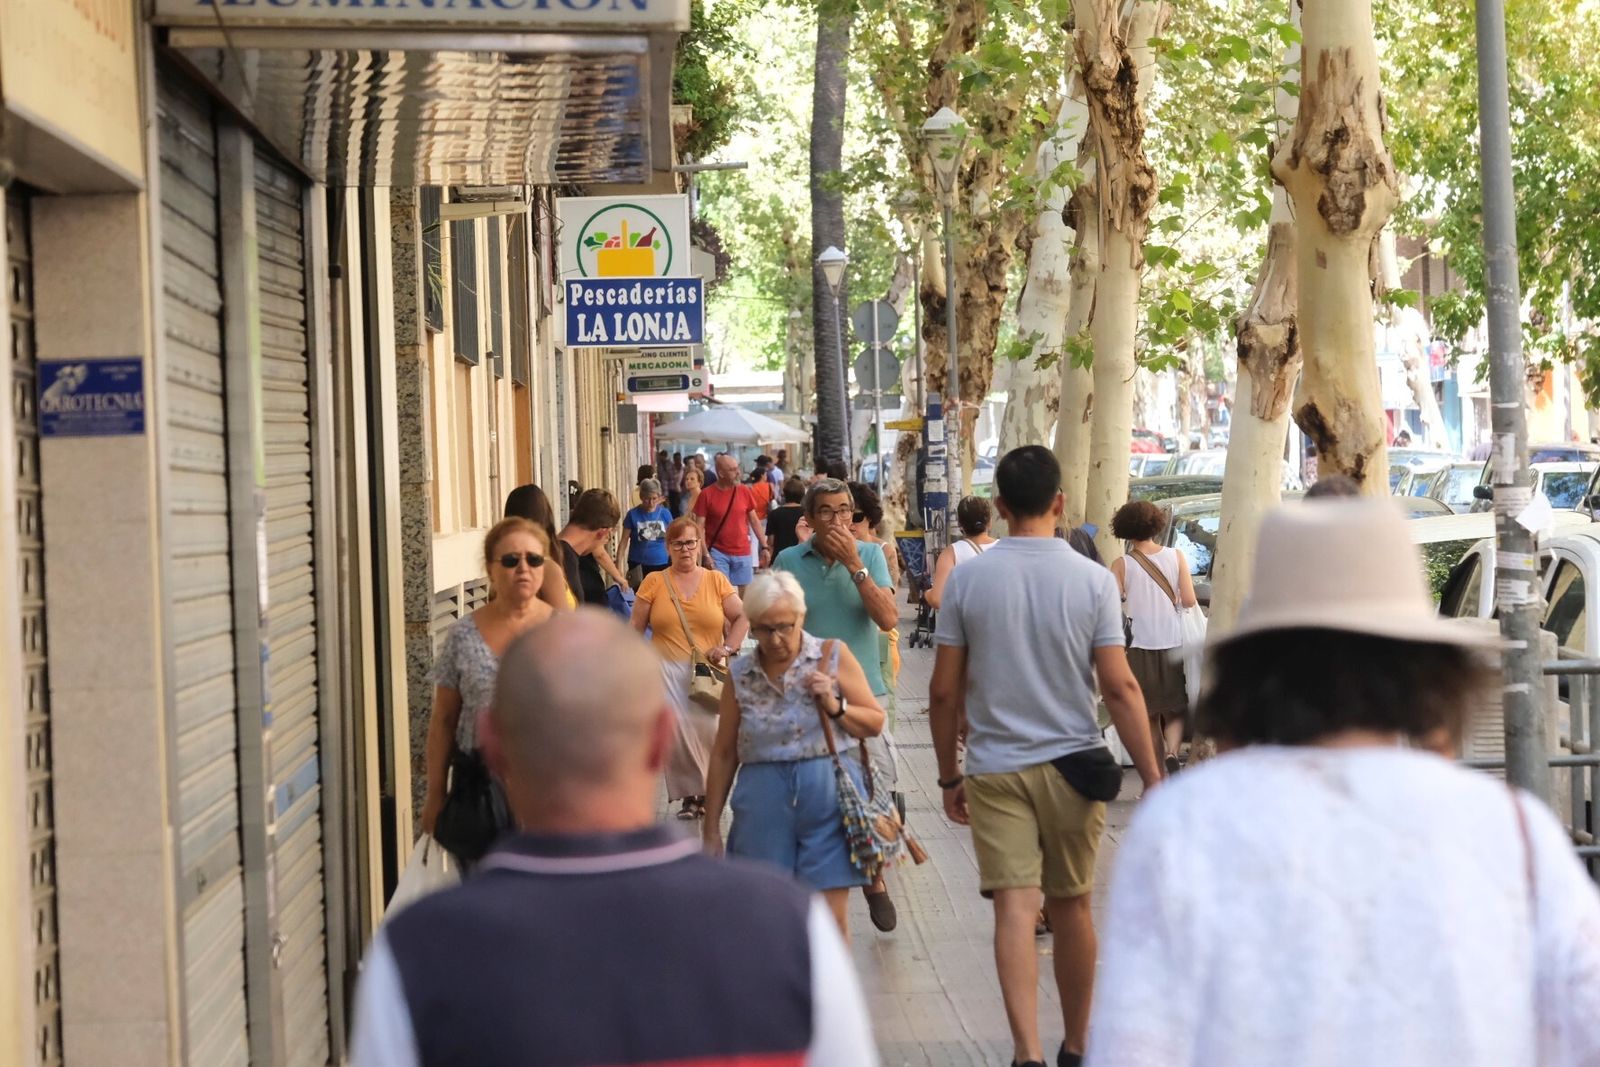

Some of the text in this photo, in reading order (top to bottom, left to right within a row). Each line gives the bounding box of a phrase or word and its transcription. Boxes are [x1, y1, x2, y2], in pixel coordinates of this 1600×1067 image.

[570, 281, 697, 306] Pescaderías
[576, 311, 692, 343] LA LONJA
[659, 350, 689, 358] CLIENTES
[628, 361, 690, 370] MERCADONA
